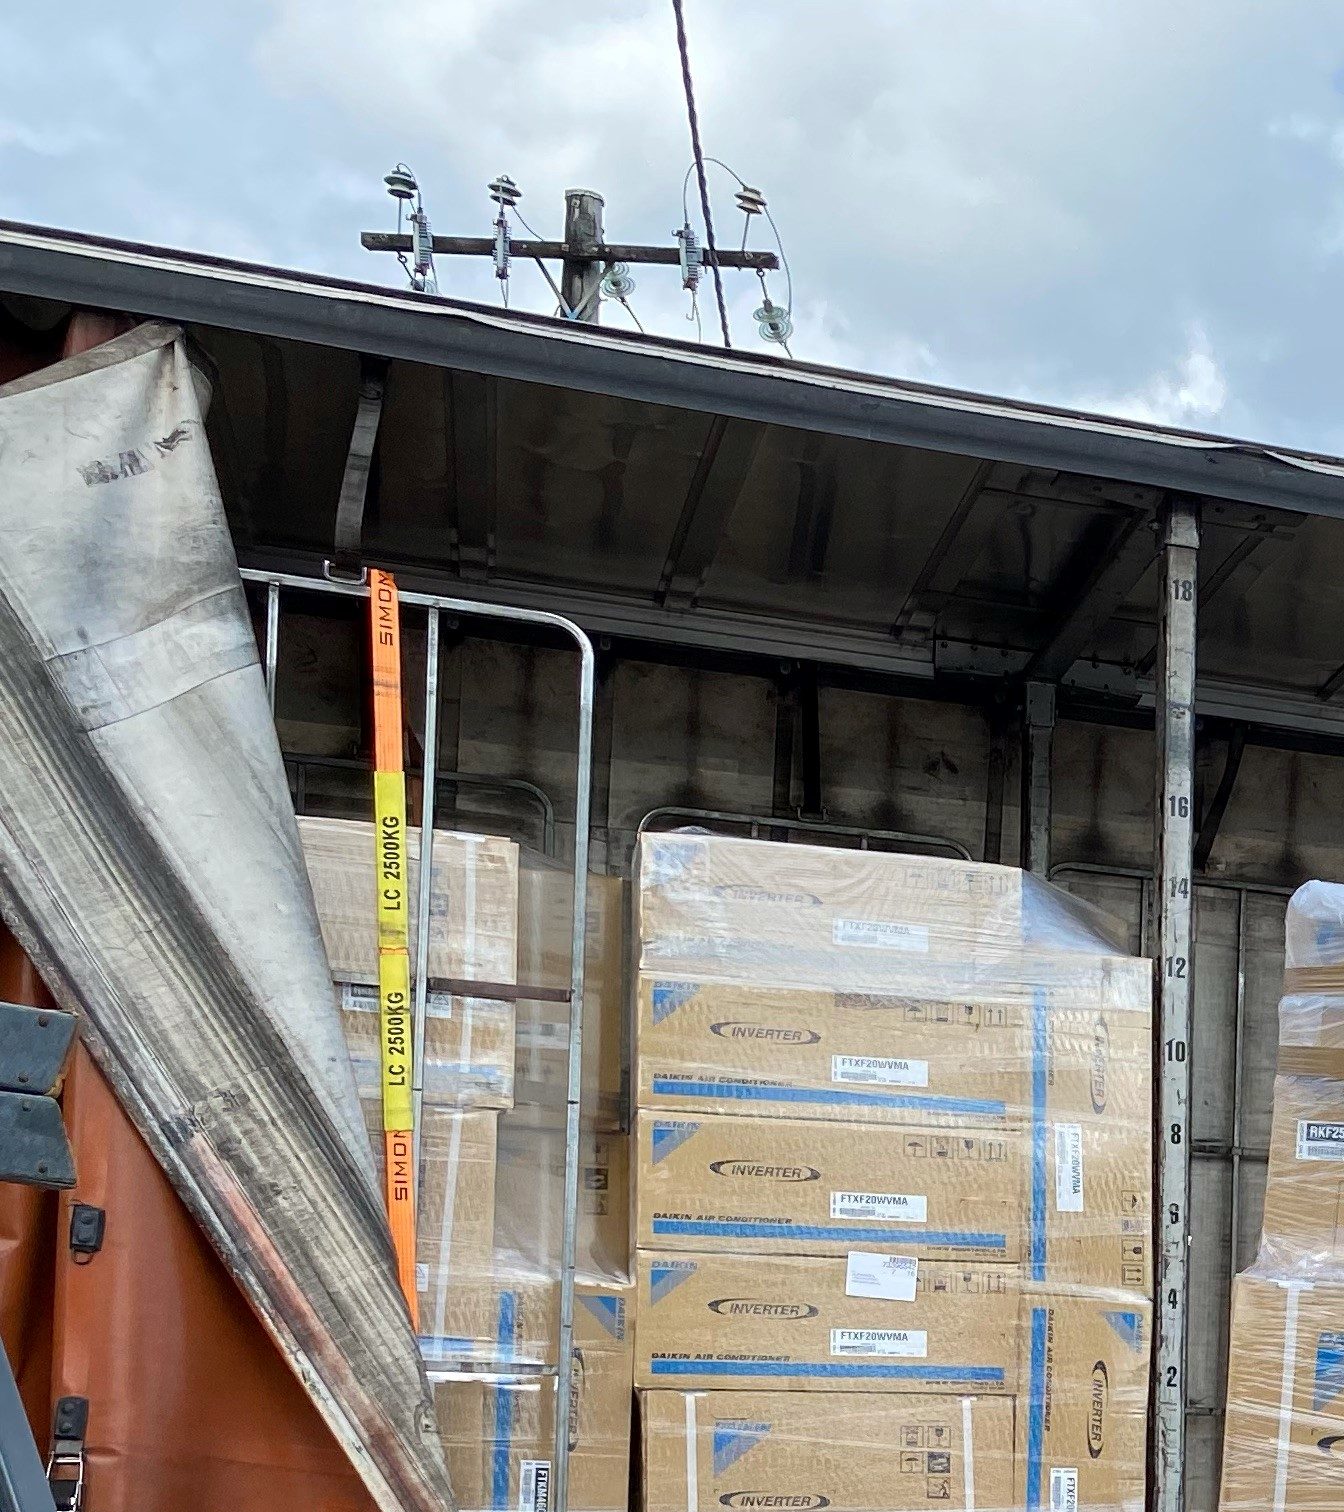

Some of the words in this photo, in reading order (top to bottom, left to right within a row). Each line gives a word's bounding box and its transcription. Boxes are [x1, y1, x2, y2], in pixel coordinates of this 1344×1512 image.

[1172, 579, 1193, 602] 18
[1168, 796, 1189, 818] 16
[382, 815, 401, 880] 2500KG
[384, 887, 401, 910] LC
[1169, 876, 1190, 899] 14
[1165, 957, 1187, 979] 12
[387, 992, 406, 1056] 2500KG
[732, 1027, 802, 1041] INVERTER
[1165, 1041, 1187, 1063] 10
[840, 1057, 910, 1071] FTXF20WVMA
[389, 1064, 406, 1087] LC
[1170, 1123, 1181, 1145] 8
[732, 1164, 802, 1179] INVERTER
[840, 1193, 909, 1207] FTXF20WVMA
[729, 1302, 800, 1316] INVERTER
[1166, 1288, 1178, 1310] 4
[840, 1331, 909, 1343] FTXF20WVMA
[651, 1352, 692, 1360] DAIKIN
[1166, 1365, 1178, 1388] 2
[1090, 1378, 1104, 1443] INVERTER
[740, 1495, 812, 1508] INVERTER
